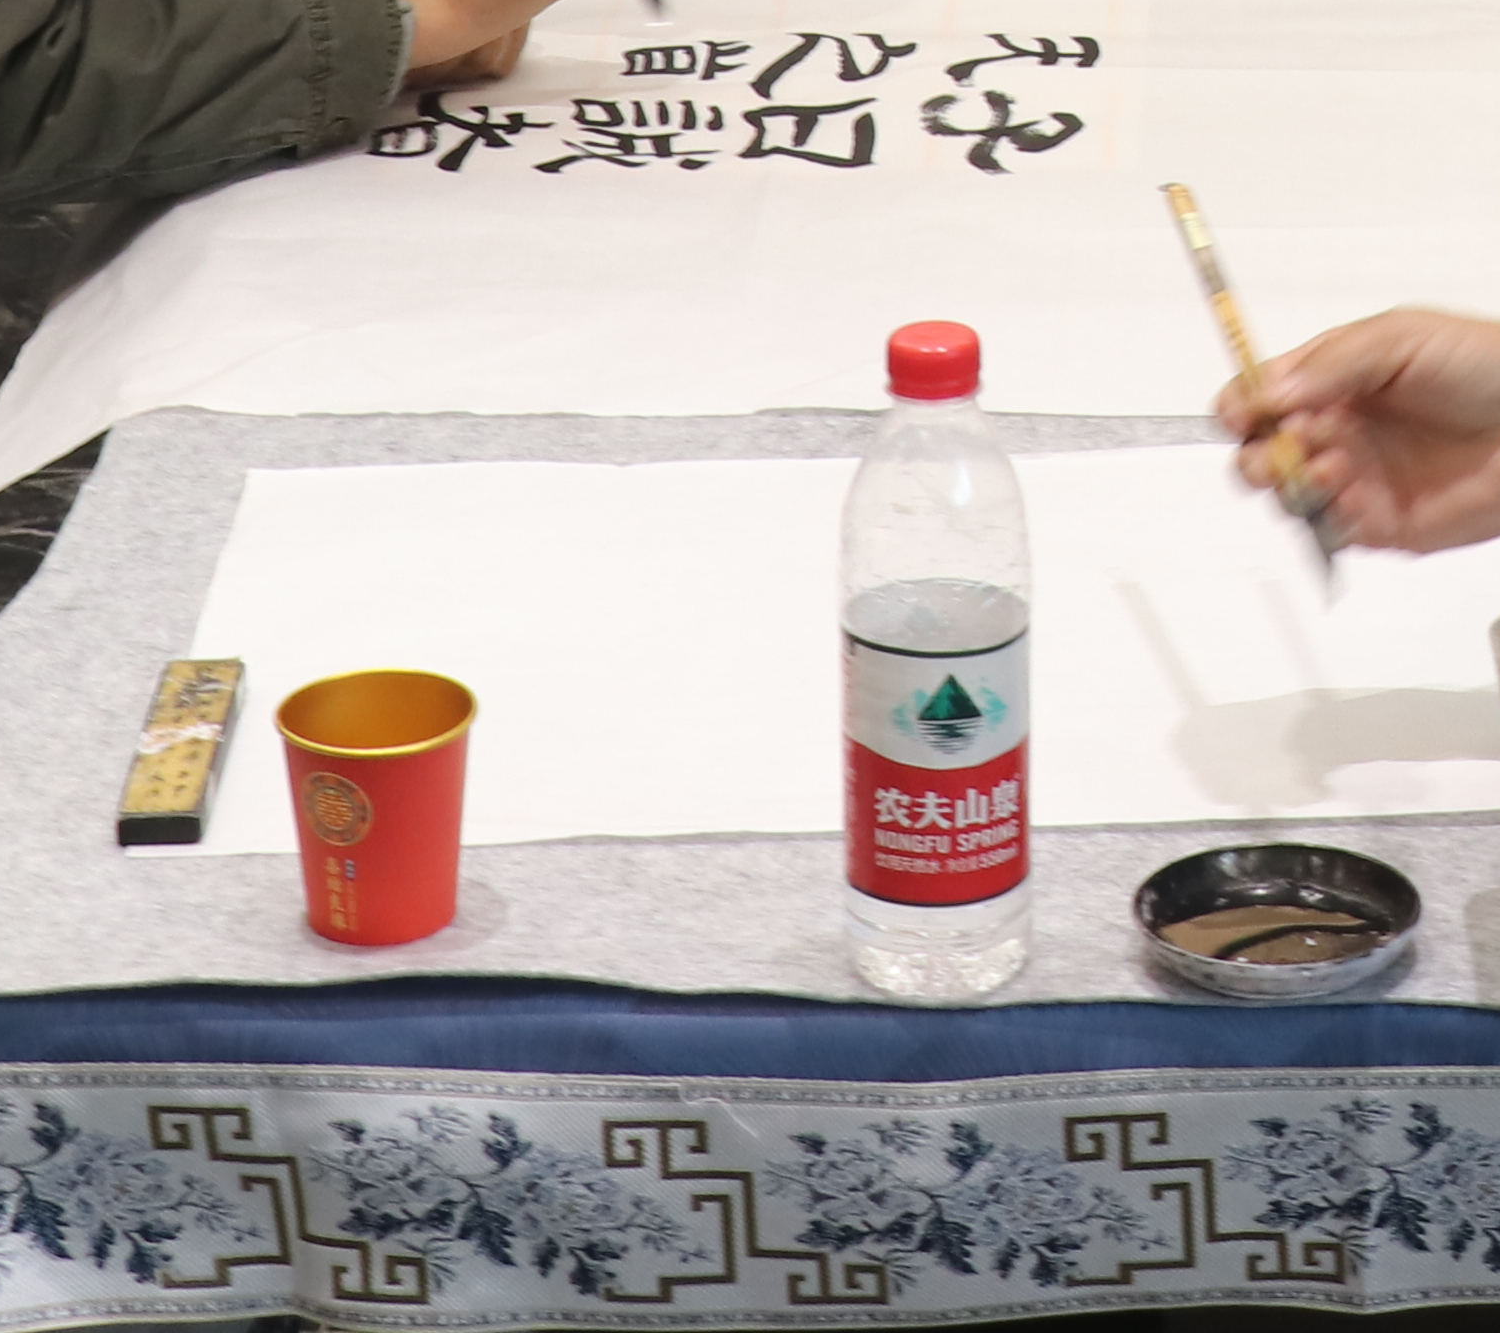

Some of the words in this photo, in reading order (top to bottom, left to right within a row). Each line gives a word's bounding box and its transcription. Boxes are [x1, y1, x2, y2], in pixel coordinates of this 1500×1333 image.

[873, 779, 1021, 830] 农夫山泉
[873, 826, 951, 854] NONGFU
[955, 819, 1021, 853] SPRING
